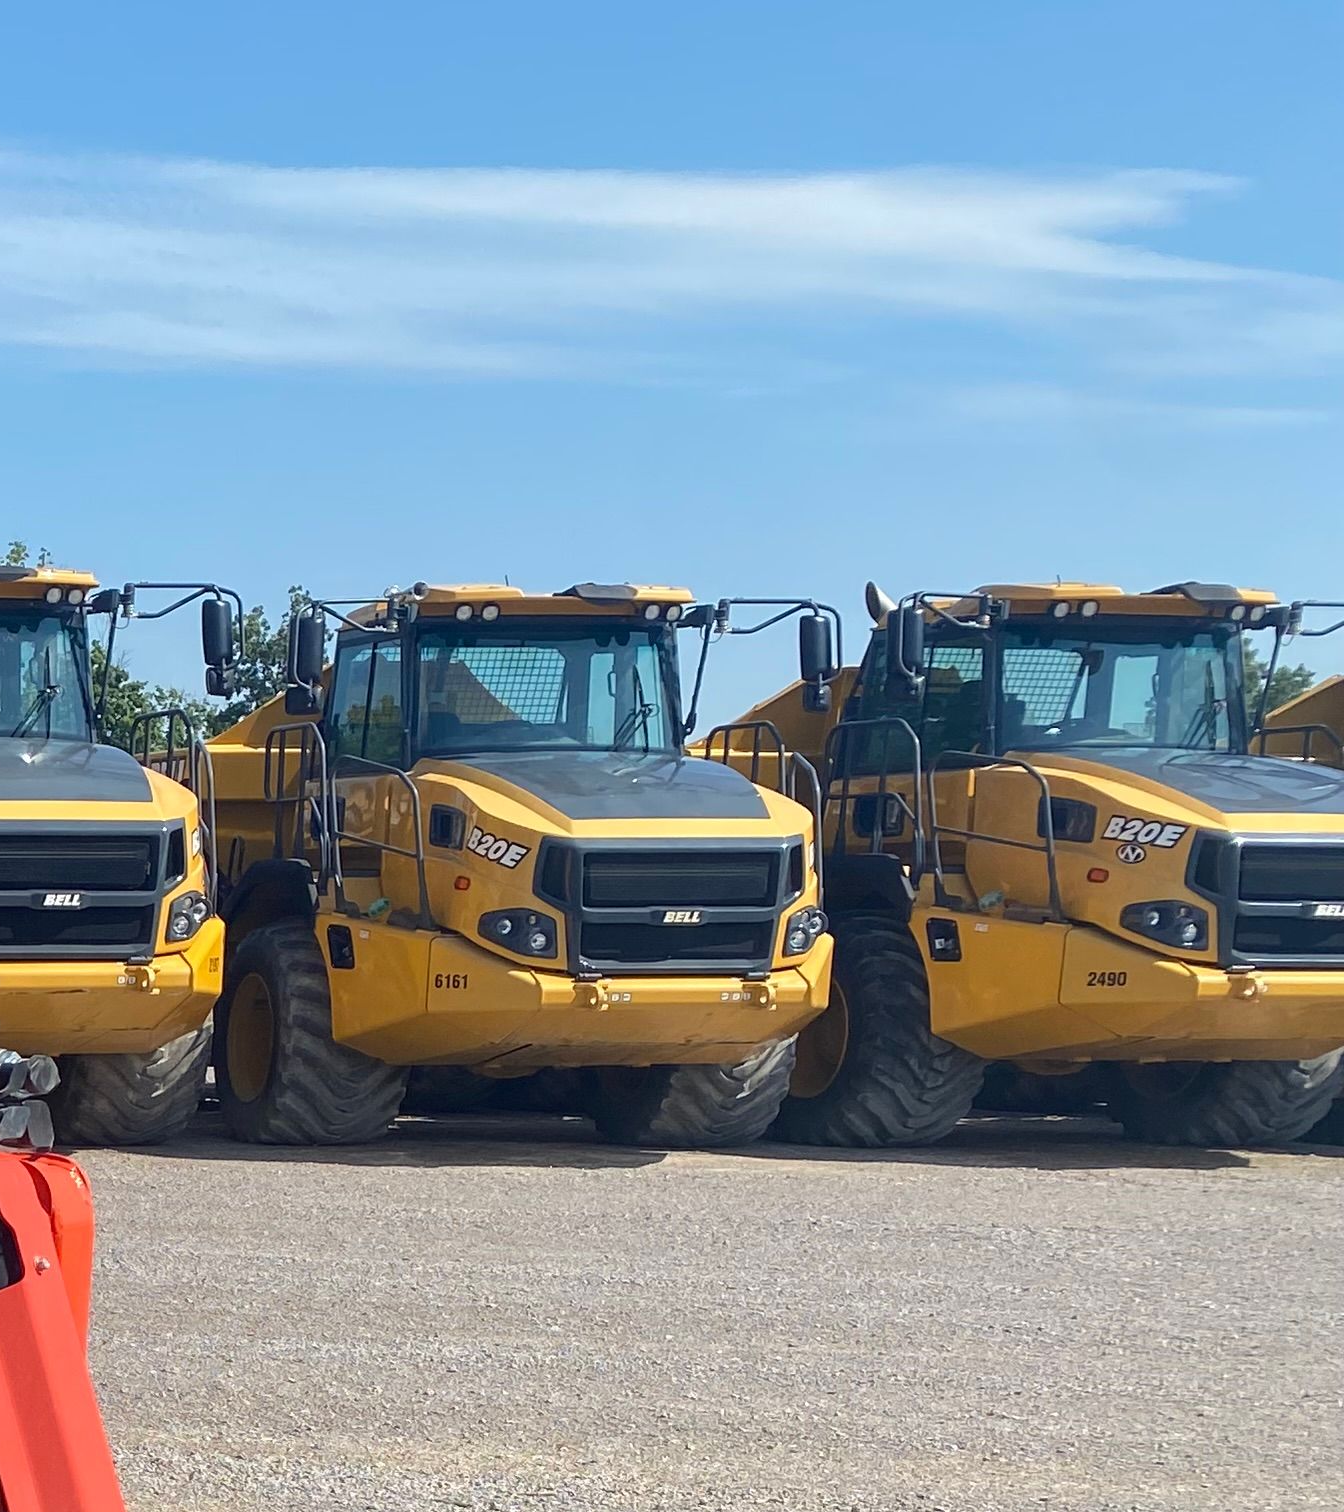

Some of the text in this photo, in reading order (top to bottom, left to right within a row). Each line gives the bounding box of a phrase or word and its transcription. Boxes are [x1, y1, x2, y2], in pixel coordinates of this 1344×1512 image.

[1101, 815, 1190, 848] B20E
[466, 827, 529, 869] B20E
[43, 893, 81, 907] BELL
[663, 910, 701, 923] BELL
[434, 973, 469, 990] 6161
[1087, 971, 1127, 987] 2490
